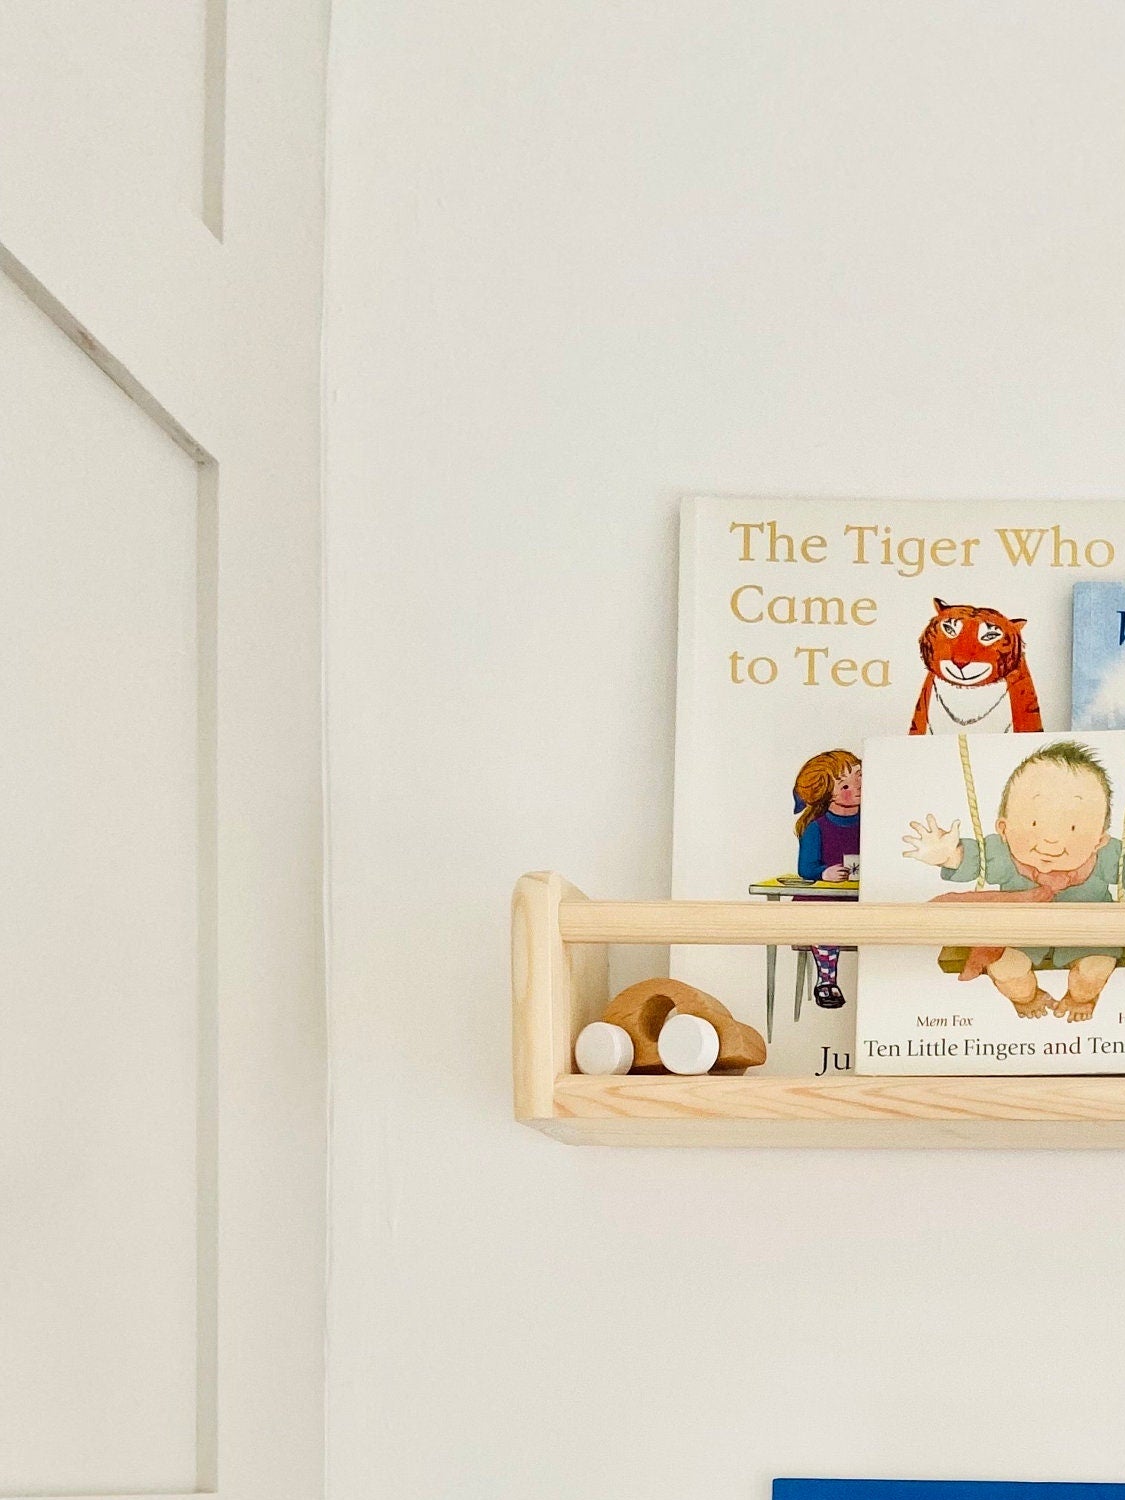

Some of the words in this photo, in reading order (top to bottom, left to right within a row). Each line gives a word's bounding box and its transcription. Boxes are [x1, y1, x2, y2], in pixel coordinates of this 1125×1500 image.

[729, 520, 828, 564] The
[843, 524, 981, 578] Tiger
[994, 524, 1115, 568] Who
[729, 584, 878, 627] Came
[728, 650, 779, 685] to
[794, 646, 892, 688] Tea
[916, 1015, 949, 1028] Mem
[952, 1014, 974, 1027] Fox
[863, 1040, 901, 1058] Ten
[907, 1038, 959, 1057] Little
[964, 1039, 1036, 1061] Fingers
[1043, 1036, 1081, 1055] and
[1087, 1037, 1125, 1054] Ten
